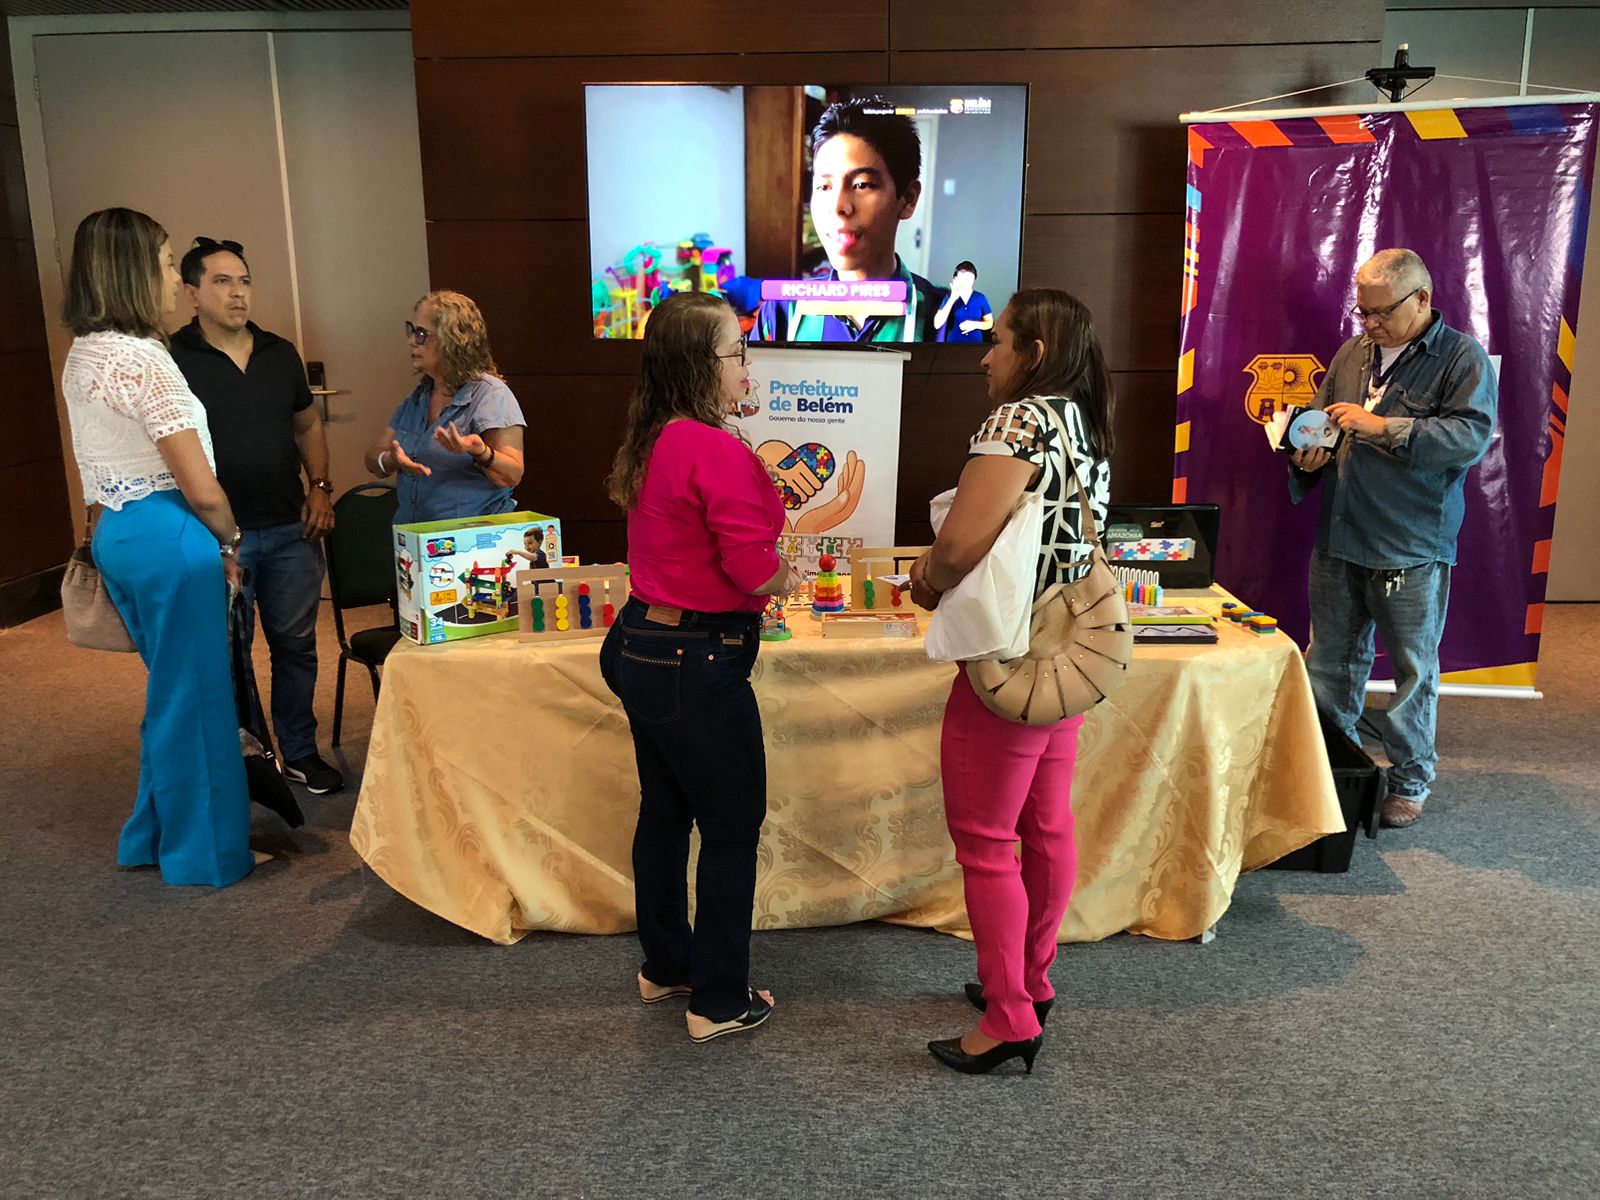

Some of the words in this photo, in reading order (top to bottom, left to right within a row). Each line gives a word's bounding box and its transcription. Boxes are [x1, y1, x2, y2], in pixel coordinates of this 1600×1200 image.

[781, 284, 848, 297] RICHARD
[850, 284, 890, 297] PIRES
[769, 379, 858, 397] Prefeitura
[768, 396, 792, 411] de
[797, 396, 853, 413] Belém
[430, 616, 444, 627] 34
